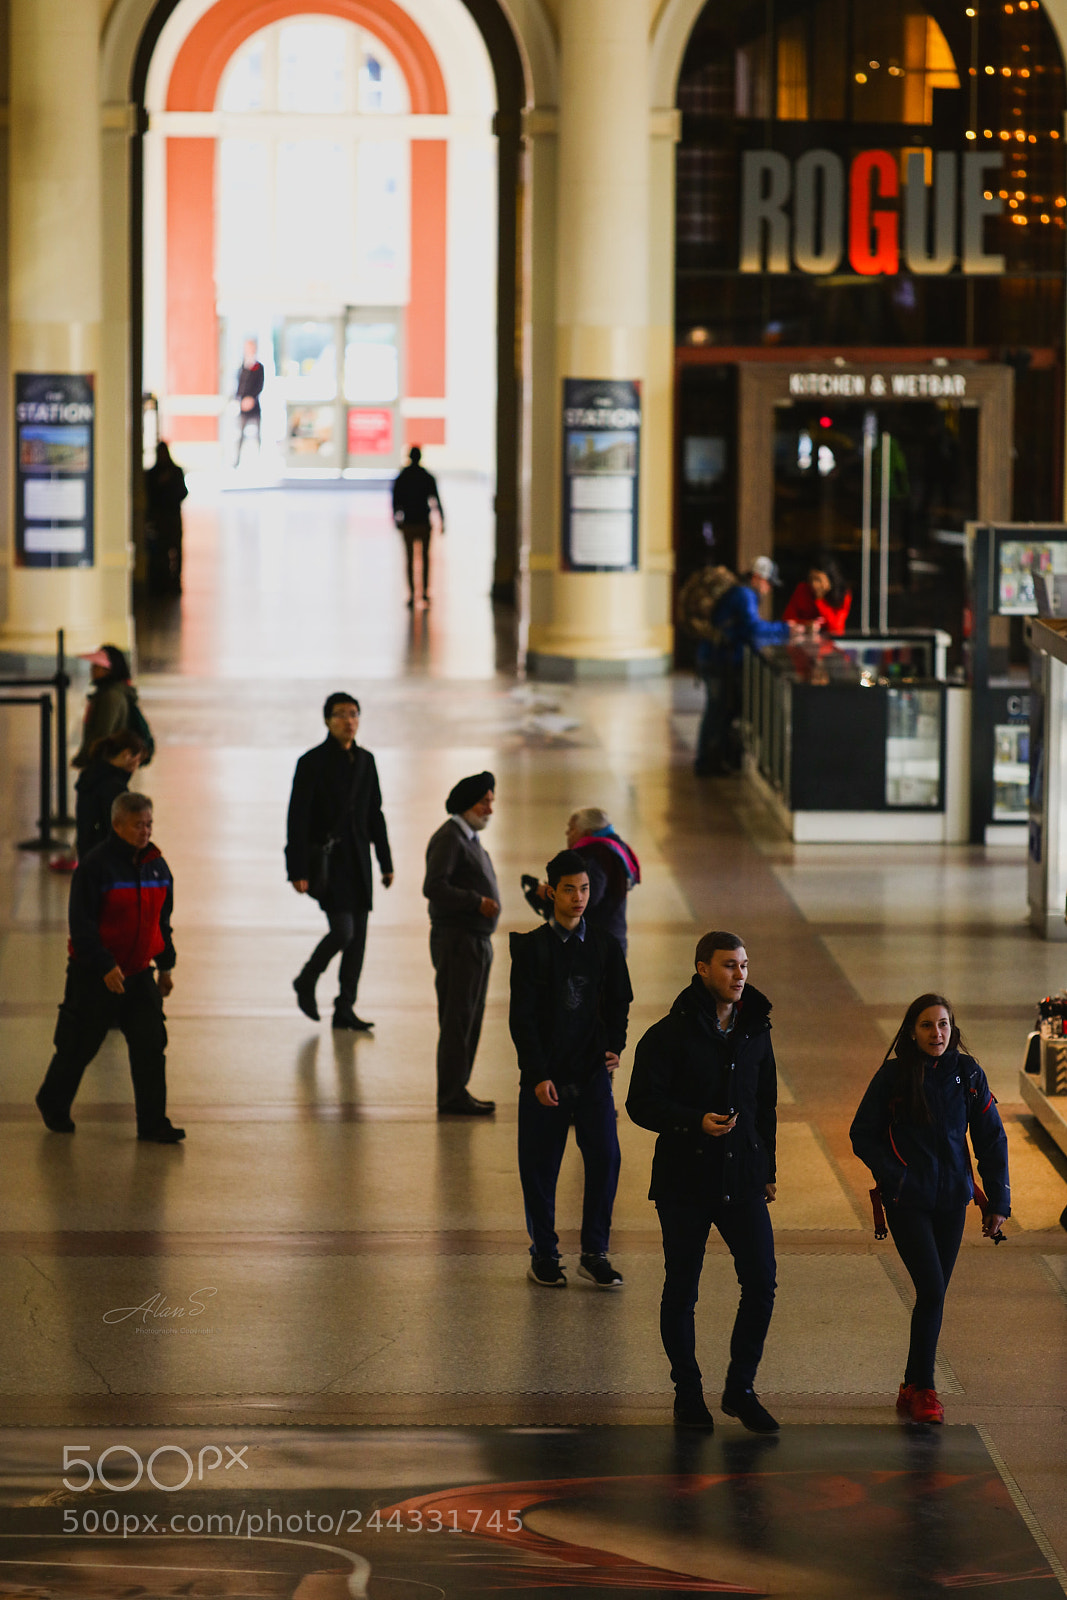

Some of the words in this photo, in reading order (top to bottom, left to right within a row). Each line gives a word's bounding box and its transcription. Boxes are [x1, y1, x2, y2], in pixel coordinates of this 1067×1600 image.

[738, 148, 1006, 276] ROGUE
[789, 373, 866, 396] KITCHEN
[870, 374, 887, 397] &
[891, 373, 966, 397] WETBAR
[16, 402, 94, 423] STATION
[565, 408, 641, 428] STATION
